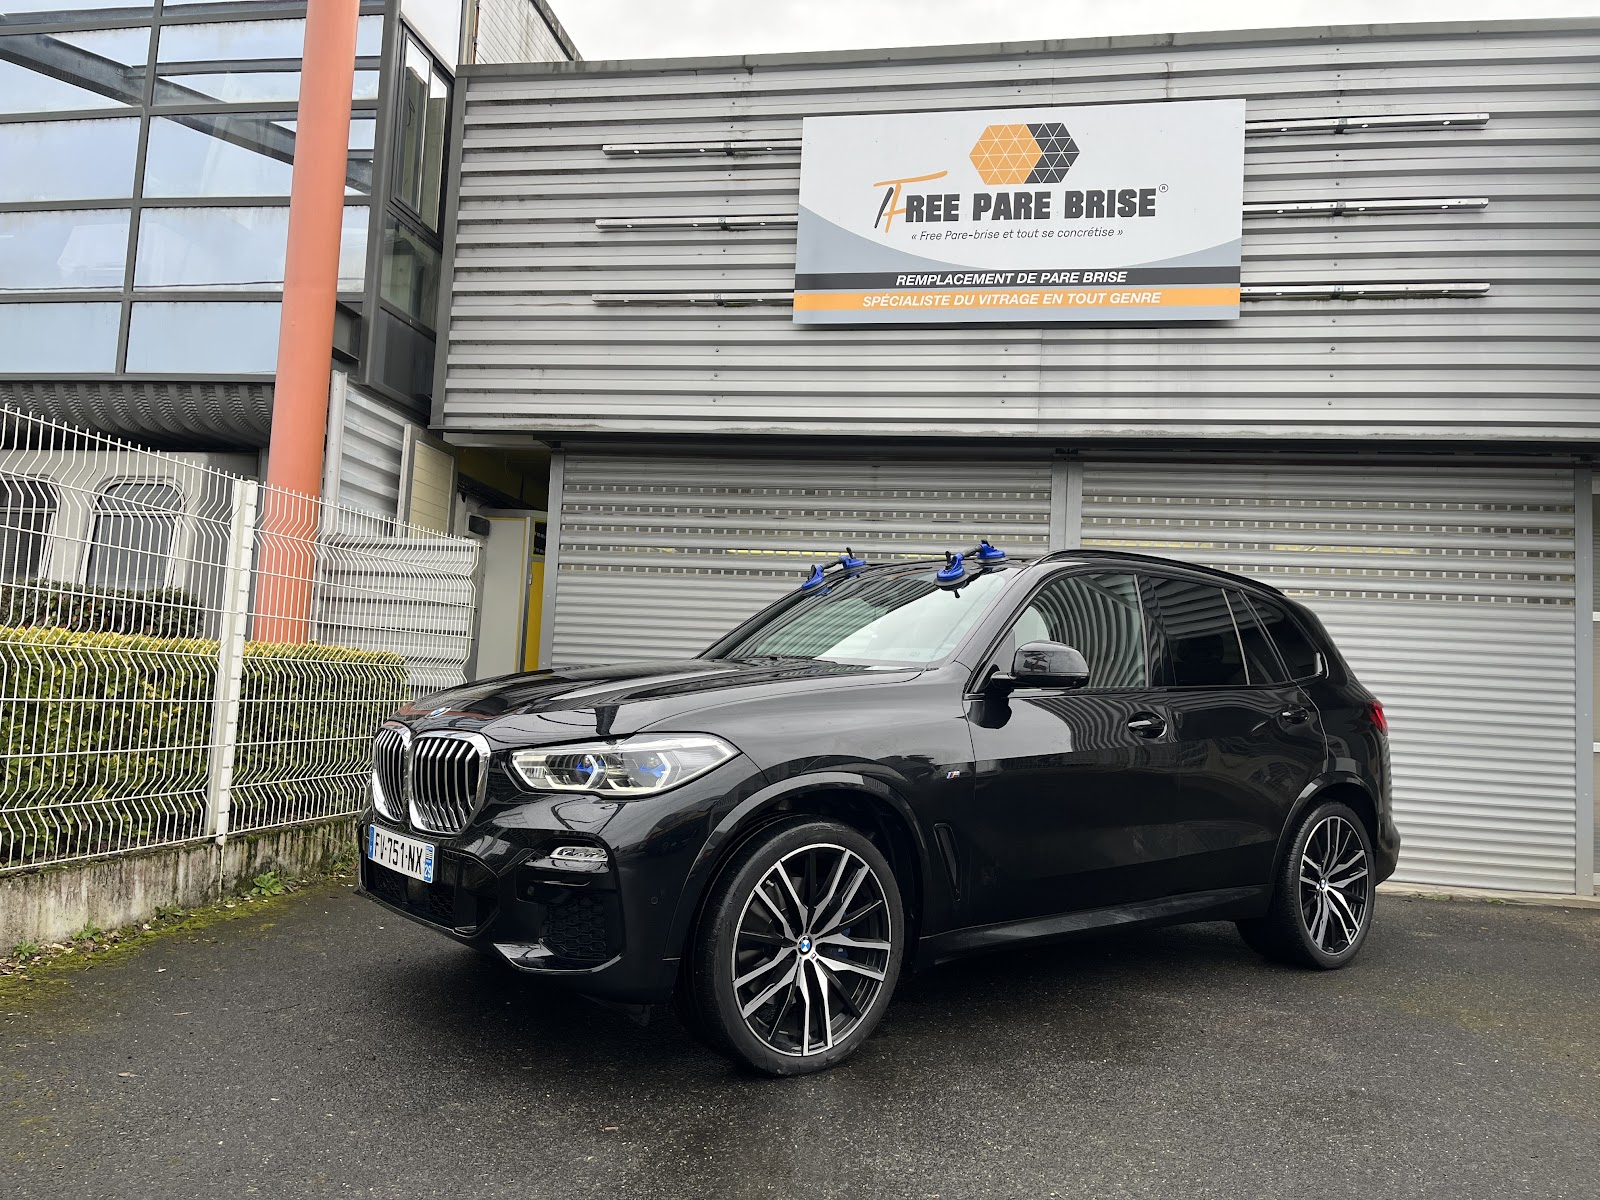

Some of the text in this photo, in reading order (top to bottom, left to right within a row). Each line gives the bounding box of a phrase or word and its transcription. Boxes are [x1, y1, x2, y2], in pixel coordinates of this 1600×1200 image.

[972, 190, 1051, 221] PARE
[919, 230, 942, 241] Free
[944, 228, 1000, 240] Pare-brise
[1002, 228, 1014, 239] et
[1016, 228, 1039, 239] tout
[1041, 229, 1054, 238] se
[1057, 226, 1114, 238] concrétise
[895, 271, 1128, 286] REMPLACEMENT DE PARE BRISE
[862, 292, 1162, 307] SPÉCIALISTE DU VITRAGE EN TOUT GENRE
[374, 832, 423, 875] FV-751-NX
[424, 864, 432, 879] 29
